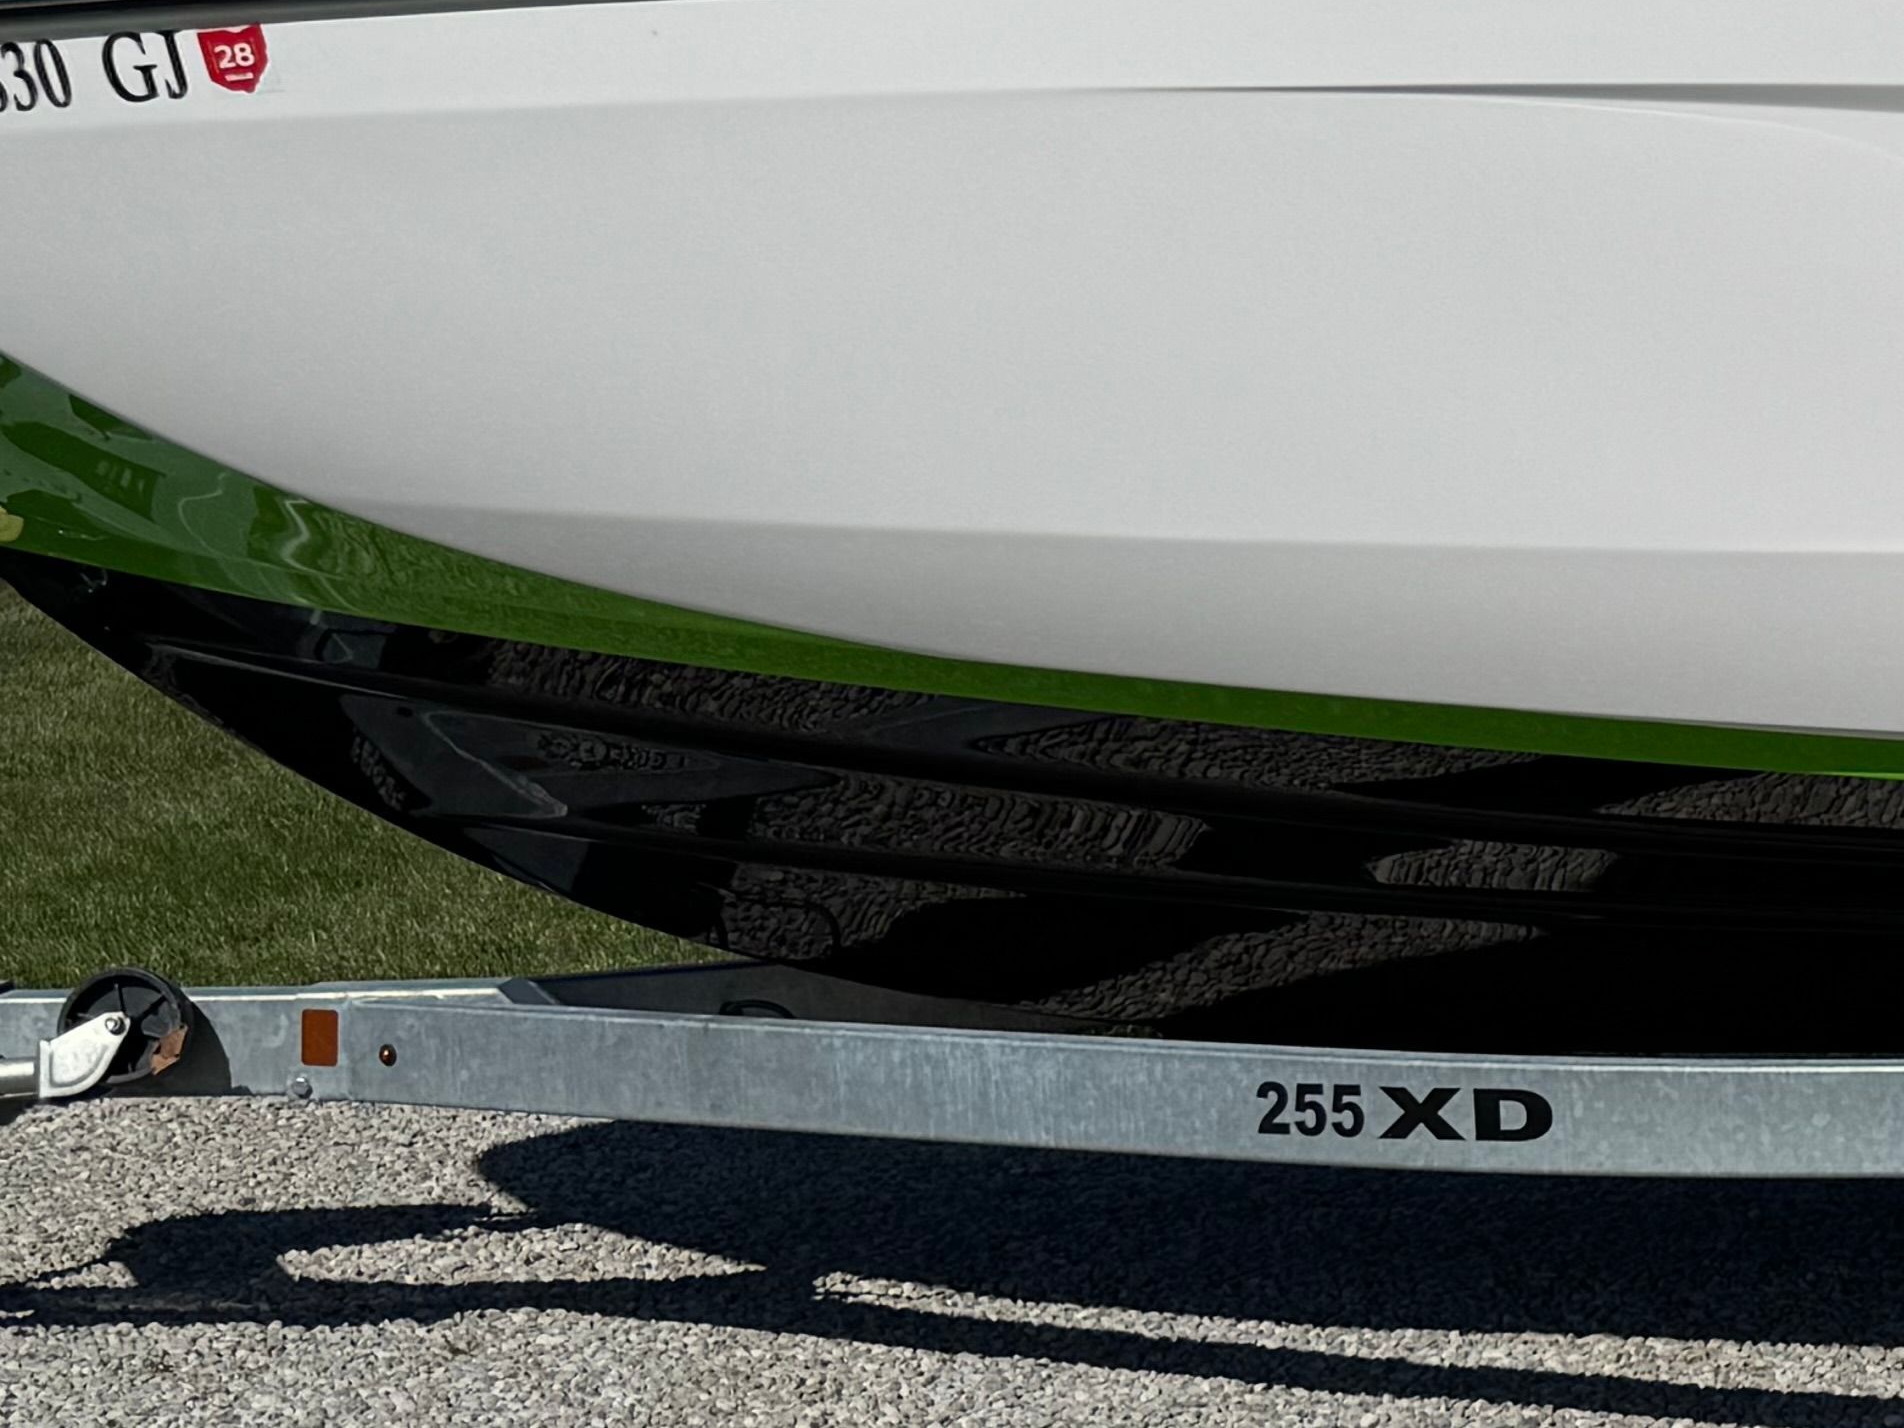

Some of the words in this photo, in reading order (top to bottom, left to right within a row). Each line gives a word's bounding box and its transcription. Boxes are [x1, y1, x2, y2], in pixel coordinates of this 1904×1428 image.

[101, 29, 188, 103] GJ
[214, 42, 255, 69] 28
[1256, 1081, 1365, 1138] 255
[1377, 1086, 1553, 1142] XD
